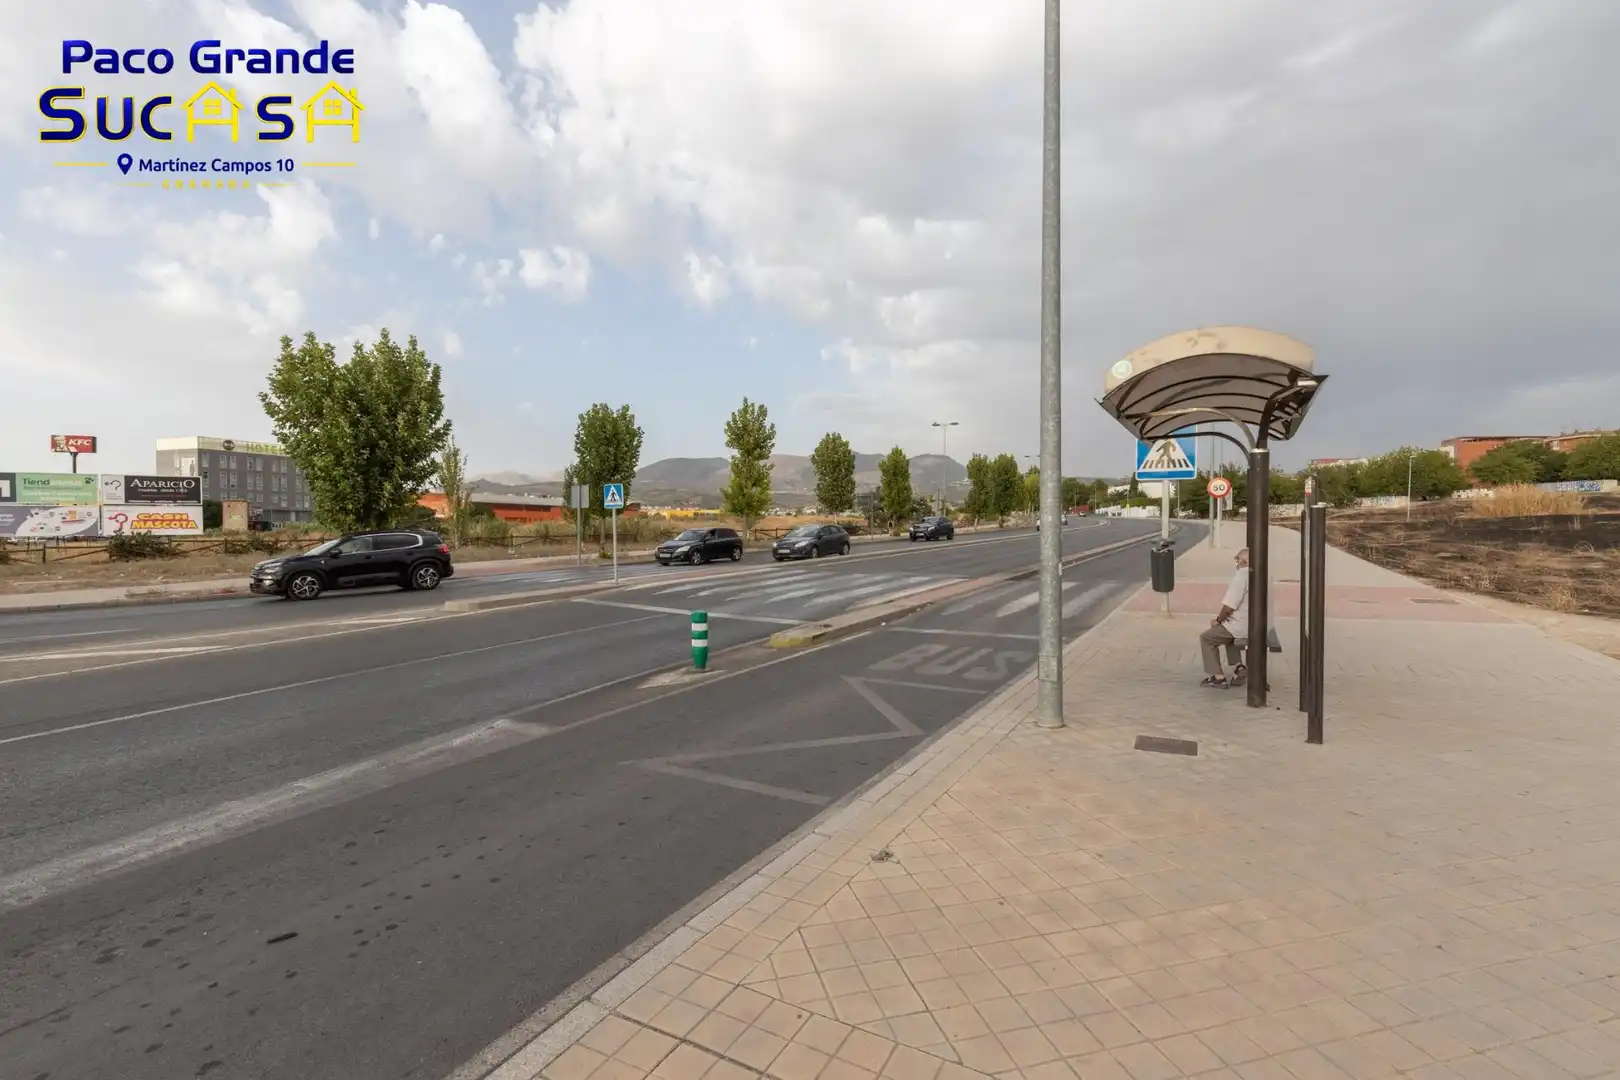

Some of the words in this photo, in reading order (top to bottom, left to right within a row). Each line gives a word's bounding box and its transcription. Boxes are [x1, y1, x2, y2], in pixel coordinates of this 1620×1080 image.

[1212, 484, 1226, 492] 50
[136, 512, 189, 521] CASH
[130, 519, 199, 530] MASCOTA
[867, 644, 1036, 681] BUS
